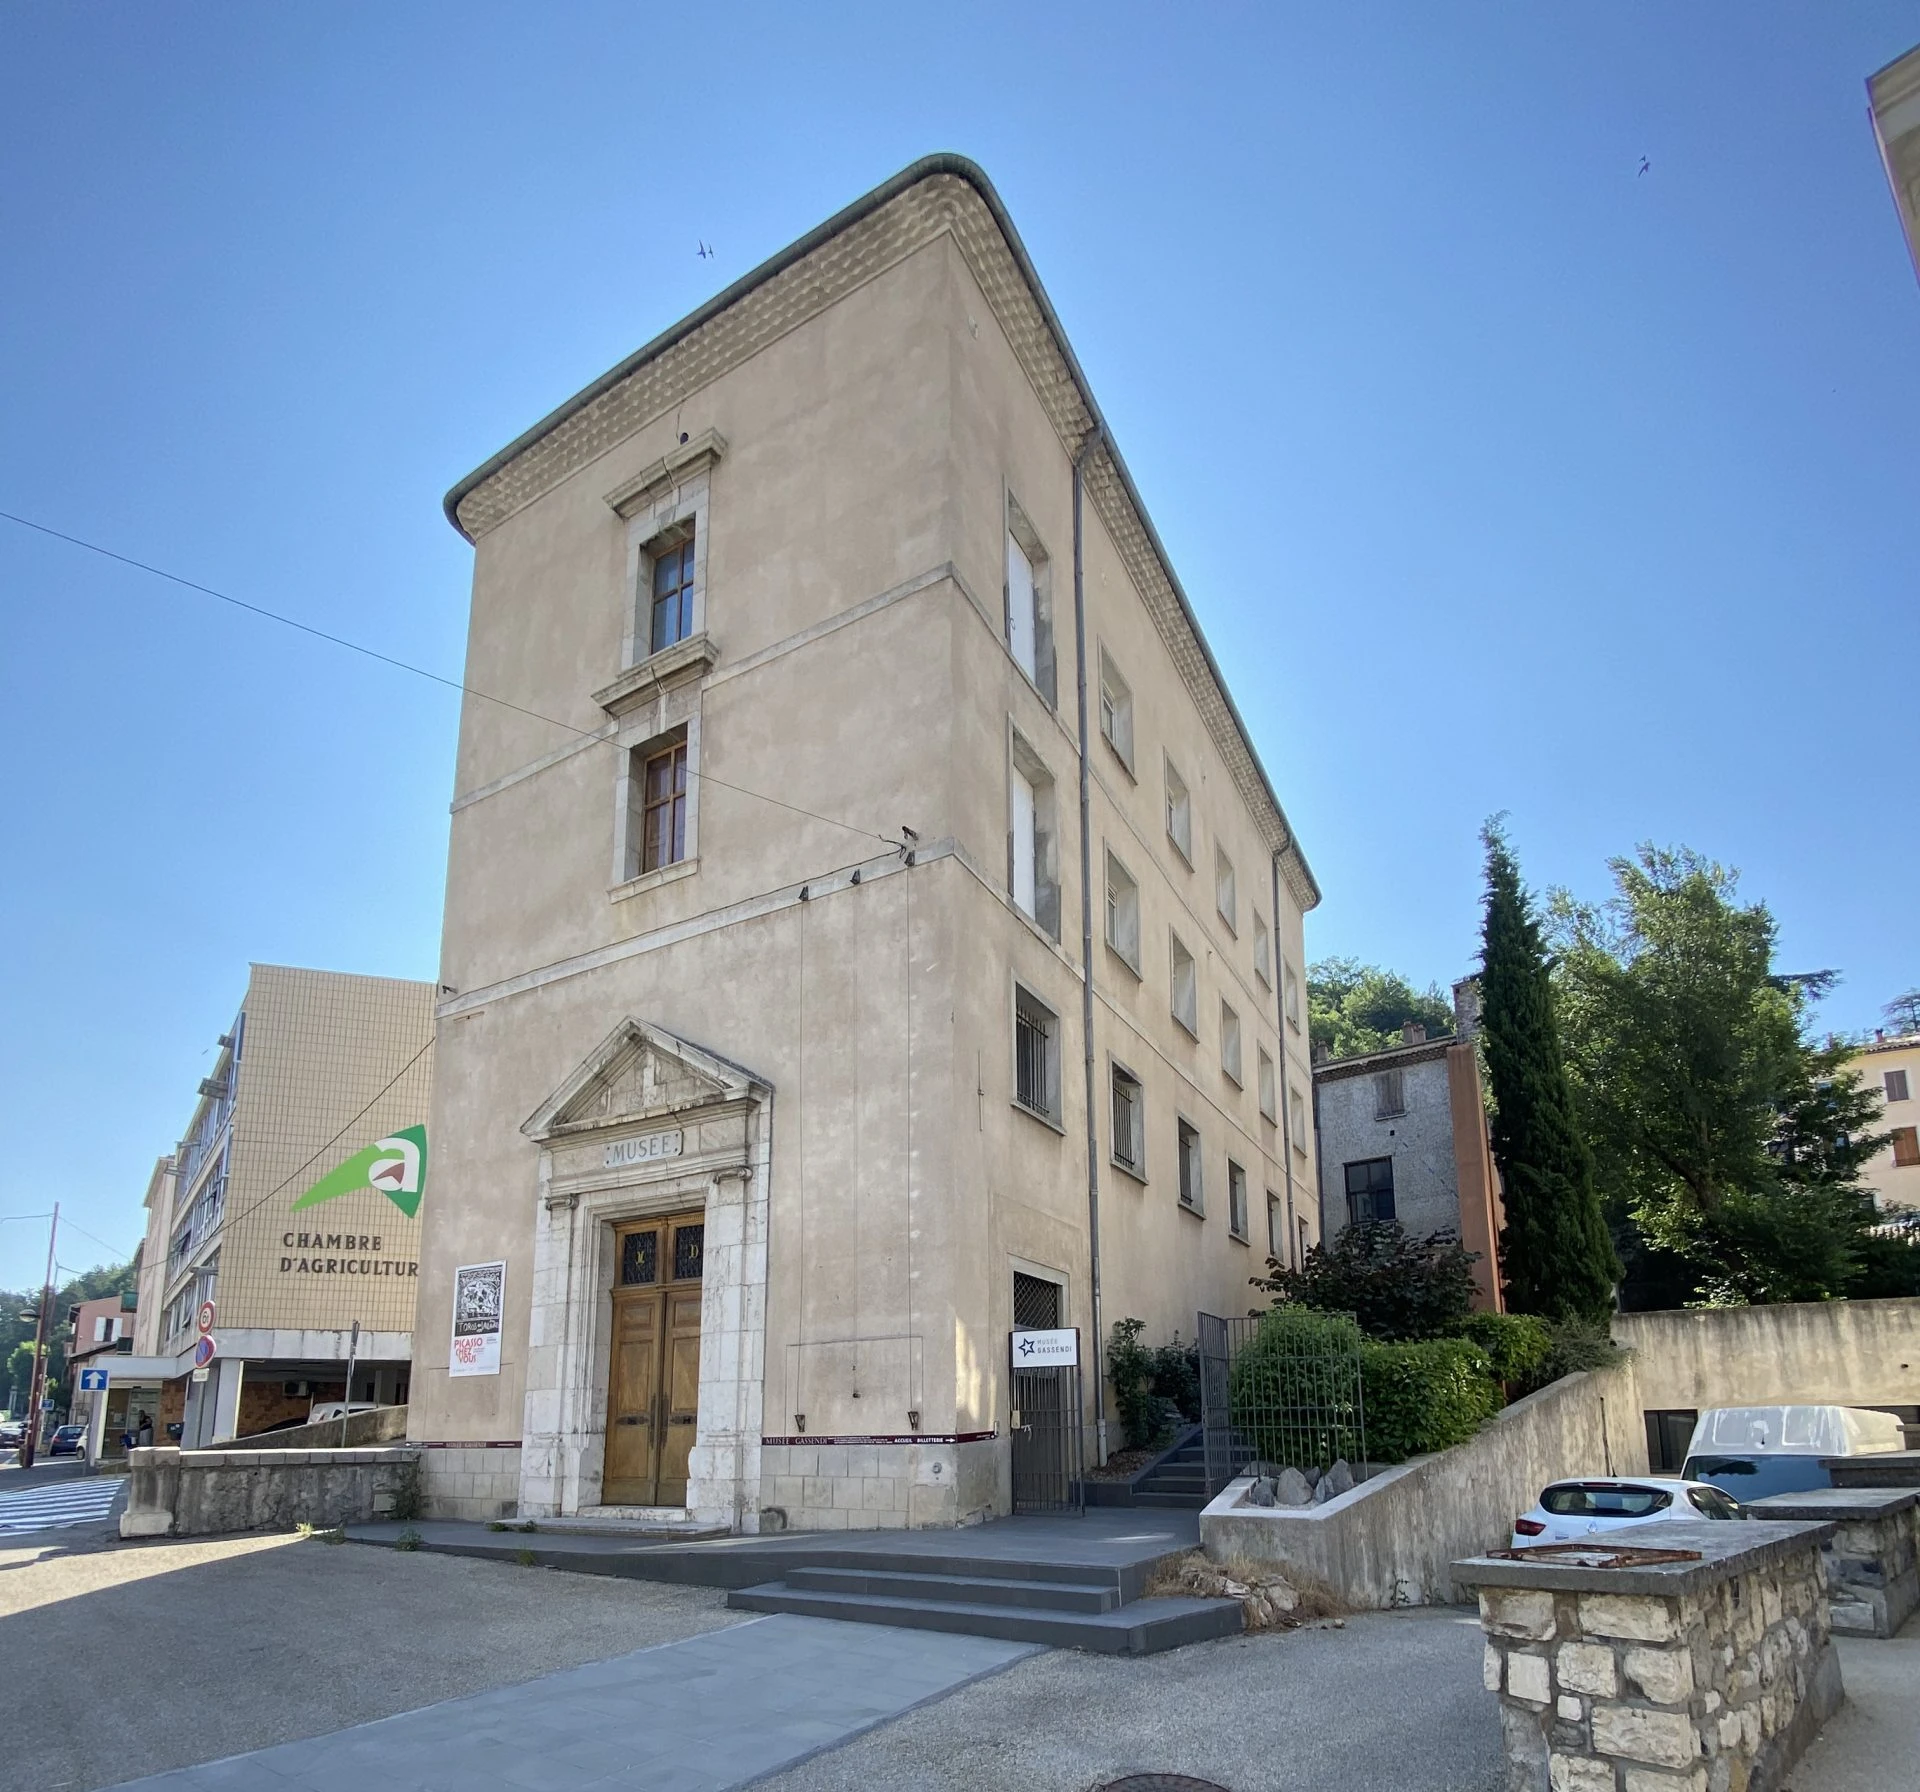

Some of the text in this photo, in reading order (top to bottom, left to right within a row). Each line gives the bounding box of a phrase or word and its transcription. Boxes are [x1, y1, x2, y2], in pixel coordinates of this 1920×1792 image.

[612, 1135, 672, 1163] MUSÉE
[283, 1232, 382, 1251] CHAMBRE
[455, 1338, 483, 1348] PICASSO
[456, 1347, 472, 1357] CHEZ
[1037, 1345, 1072, 1354] GASSENDI
[459, 1354, 477, 1364] VOUS
[795, 1437, 828, 1445] GASSENDI
